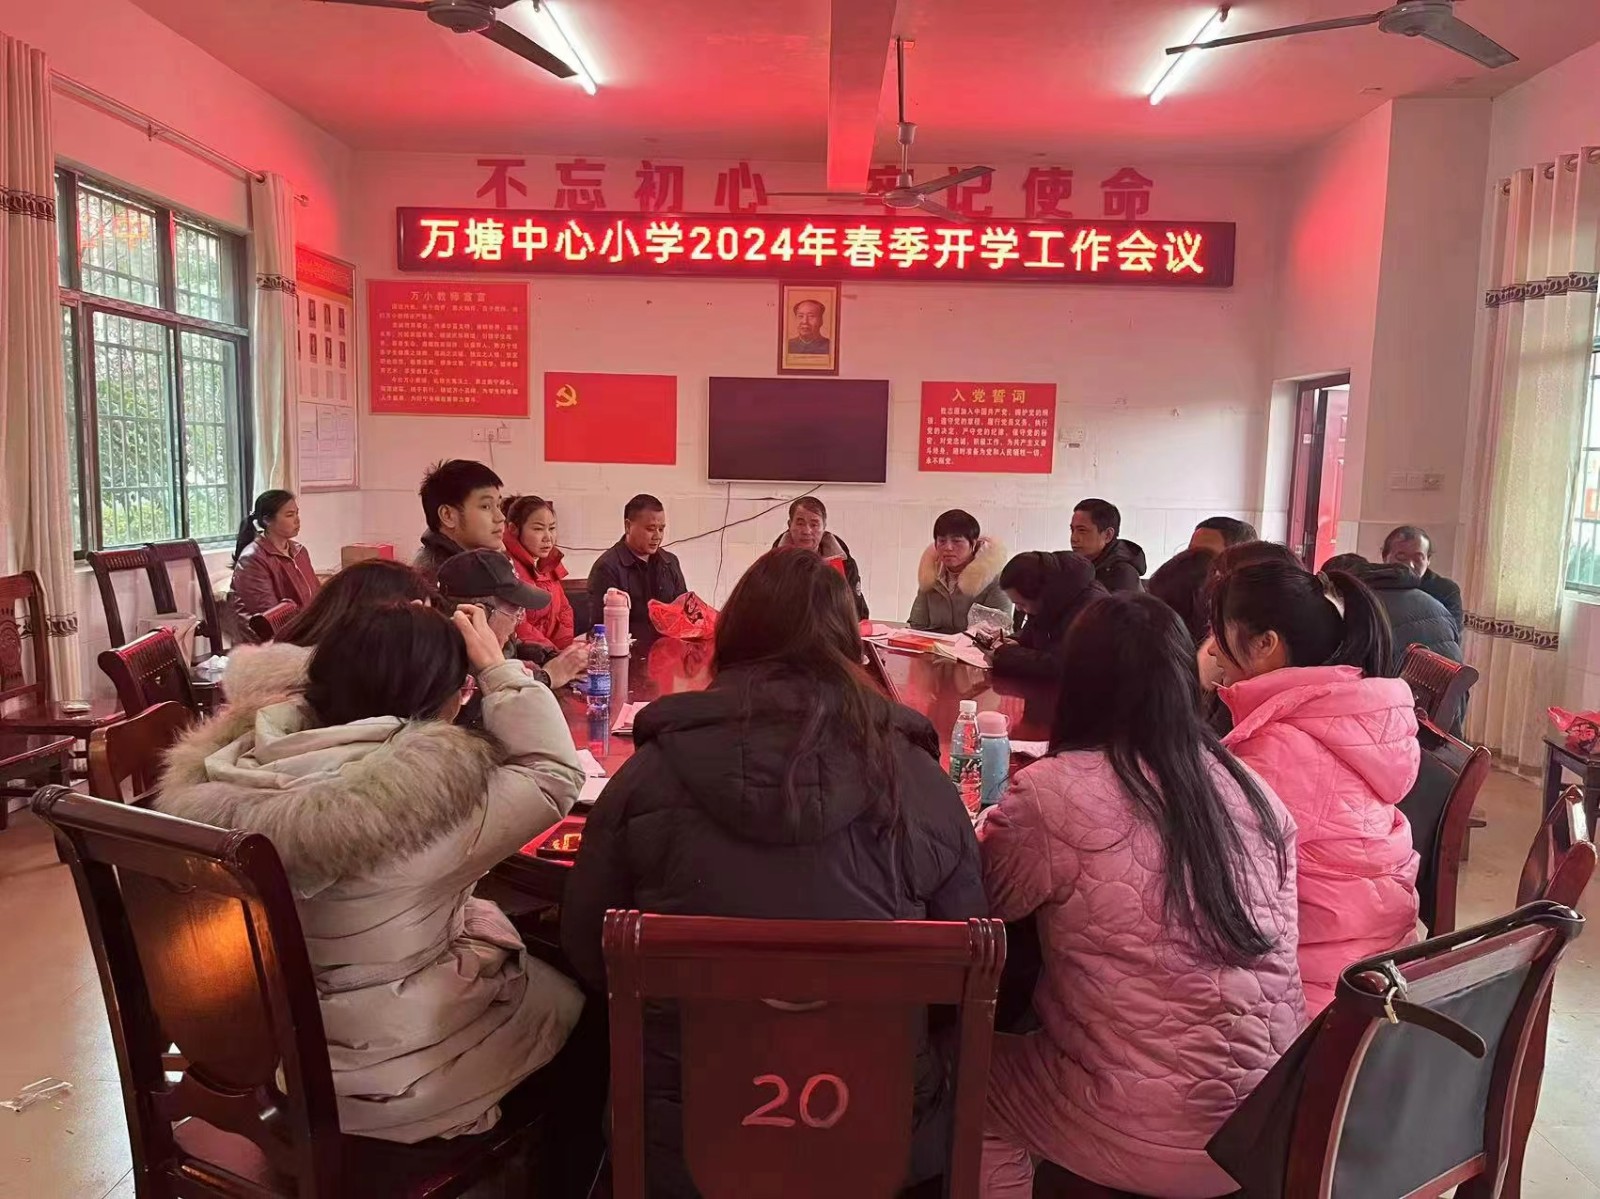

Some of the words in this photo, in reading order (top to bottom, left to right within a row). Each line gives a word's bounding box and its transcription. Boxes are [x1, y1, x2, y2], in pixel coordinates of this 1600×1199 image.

[476, 159, 769, 214] 不忘初心
[419, 218, 1204, 274] 万塘中心小学2024年春季开学工作会议
[952, 388, 1025, 403] 入党誓词
[741, 1073, 849, 1129] 20
